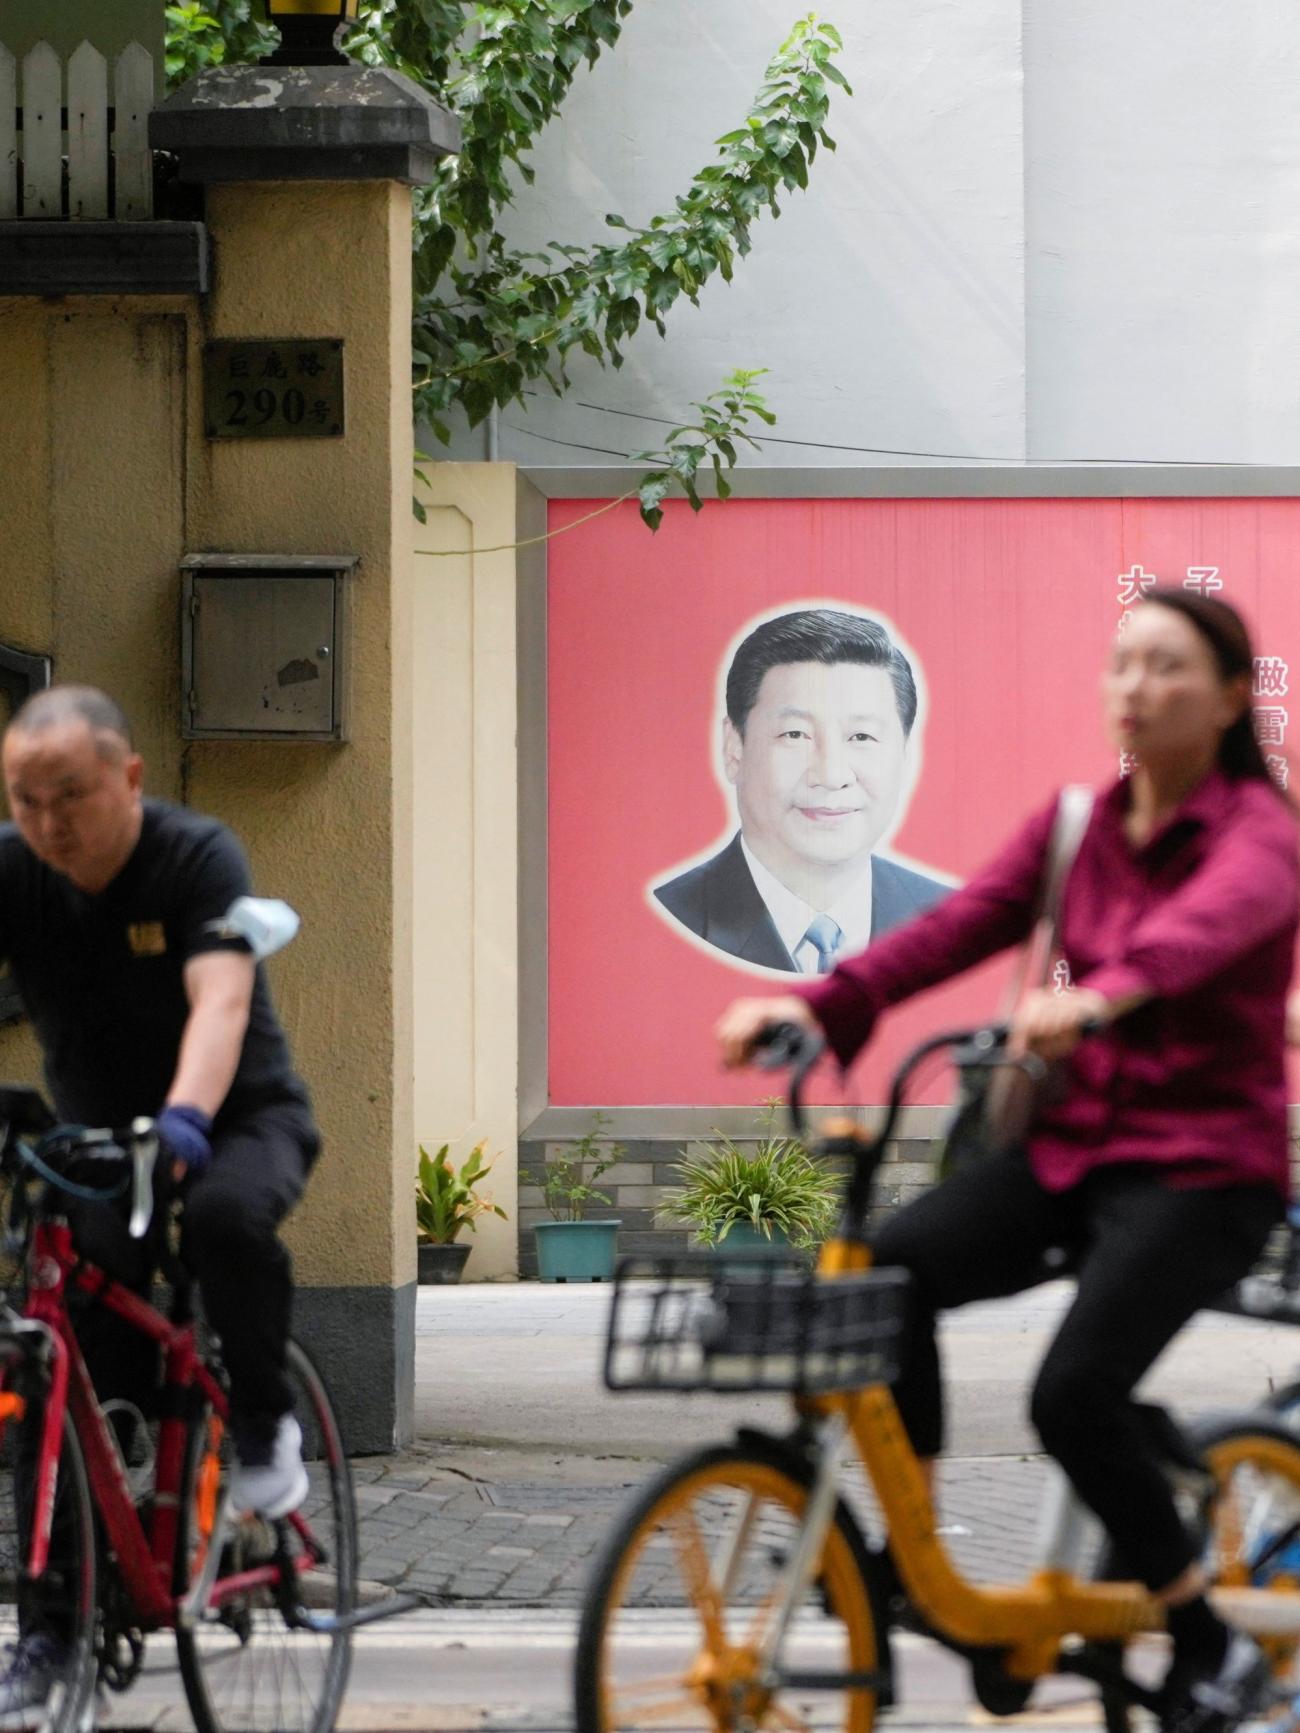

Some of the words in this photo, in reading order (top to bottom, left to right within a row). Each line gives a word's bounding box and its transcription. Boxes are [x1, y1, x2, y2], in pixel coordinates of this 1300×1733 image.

[230, 351, 326, 379] 巨鹿路
[225, 388, 331, 426] 290号
